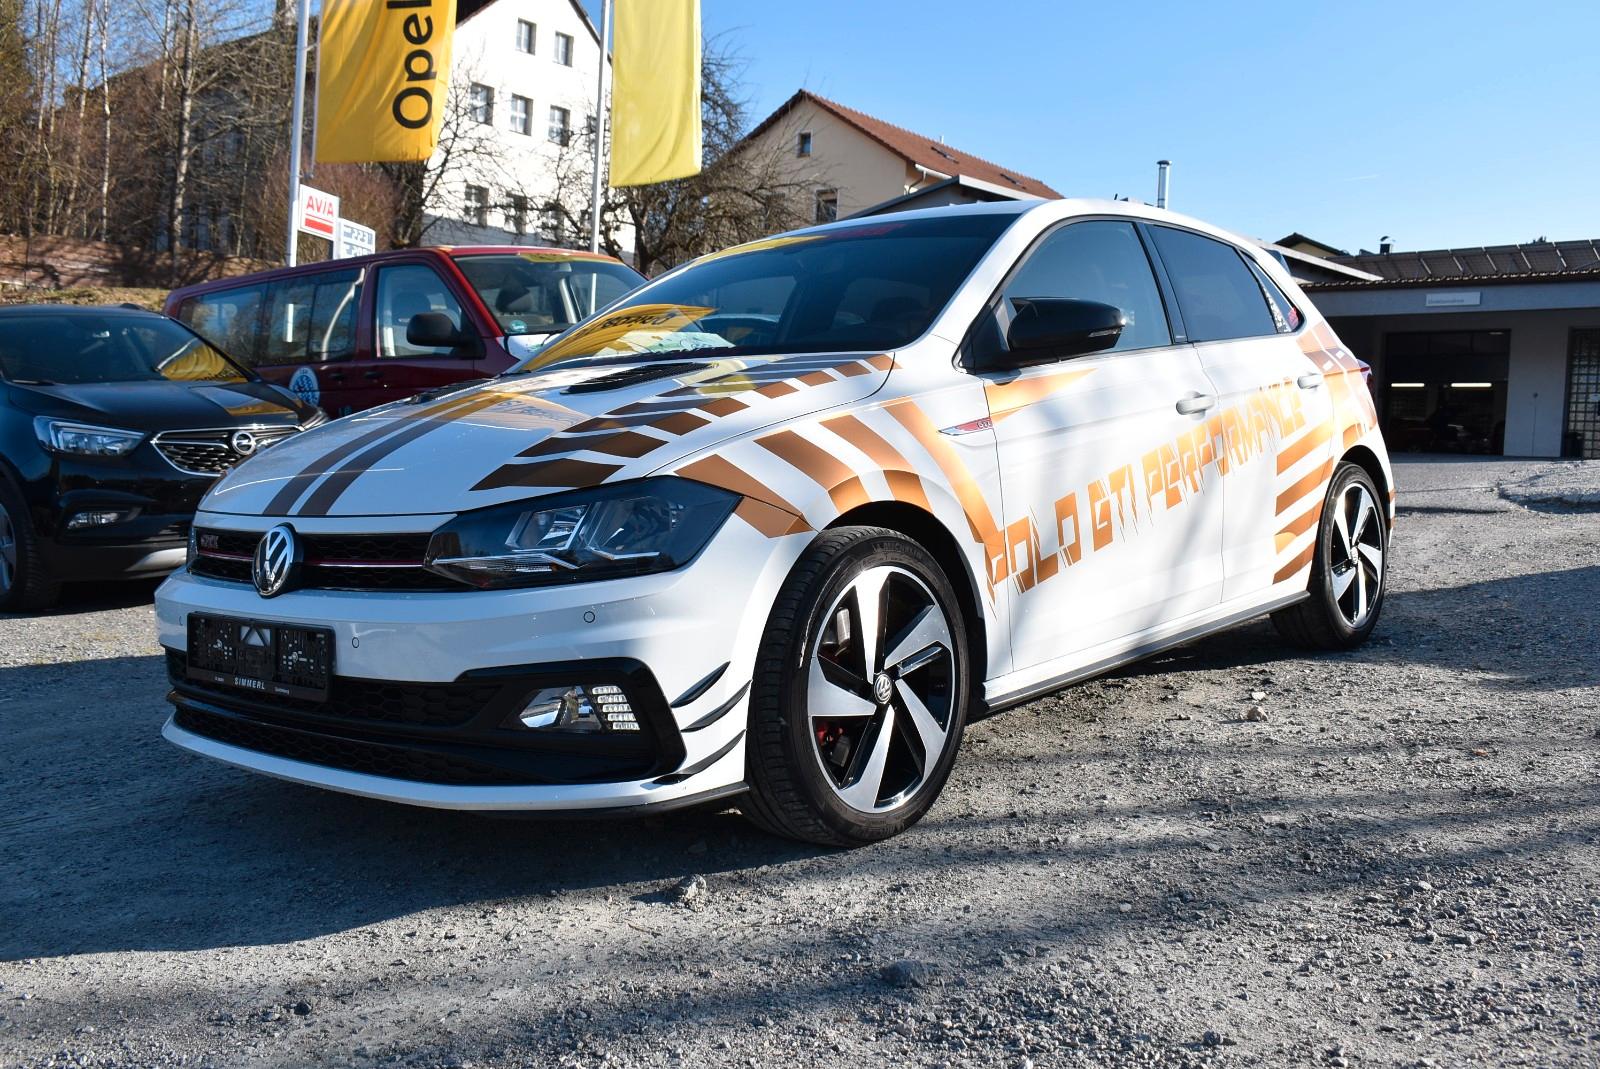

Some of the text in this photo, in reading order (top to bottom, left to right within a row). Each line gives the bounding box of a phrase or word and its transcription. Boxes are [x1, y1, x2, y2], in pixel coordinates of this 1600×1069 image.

[386, 0, 438, 129] Opel
[306, 195, 334, 217] AVIA
[1087, 463, 1139, 553] GTI
[1142, 380, 1306, 514] PERFORMANCE
